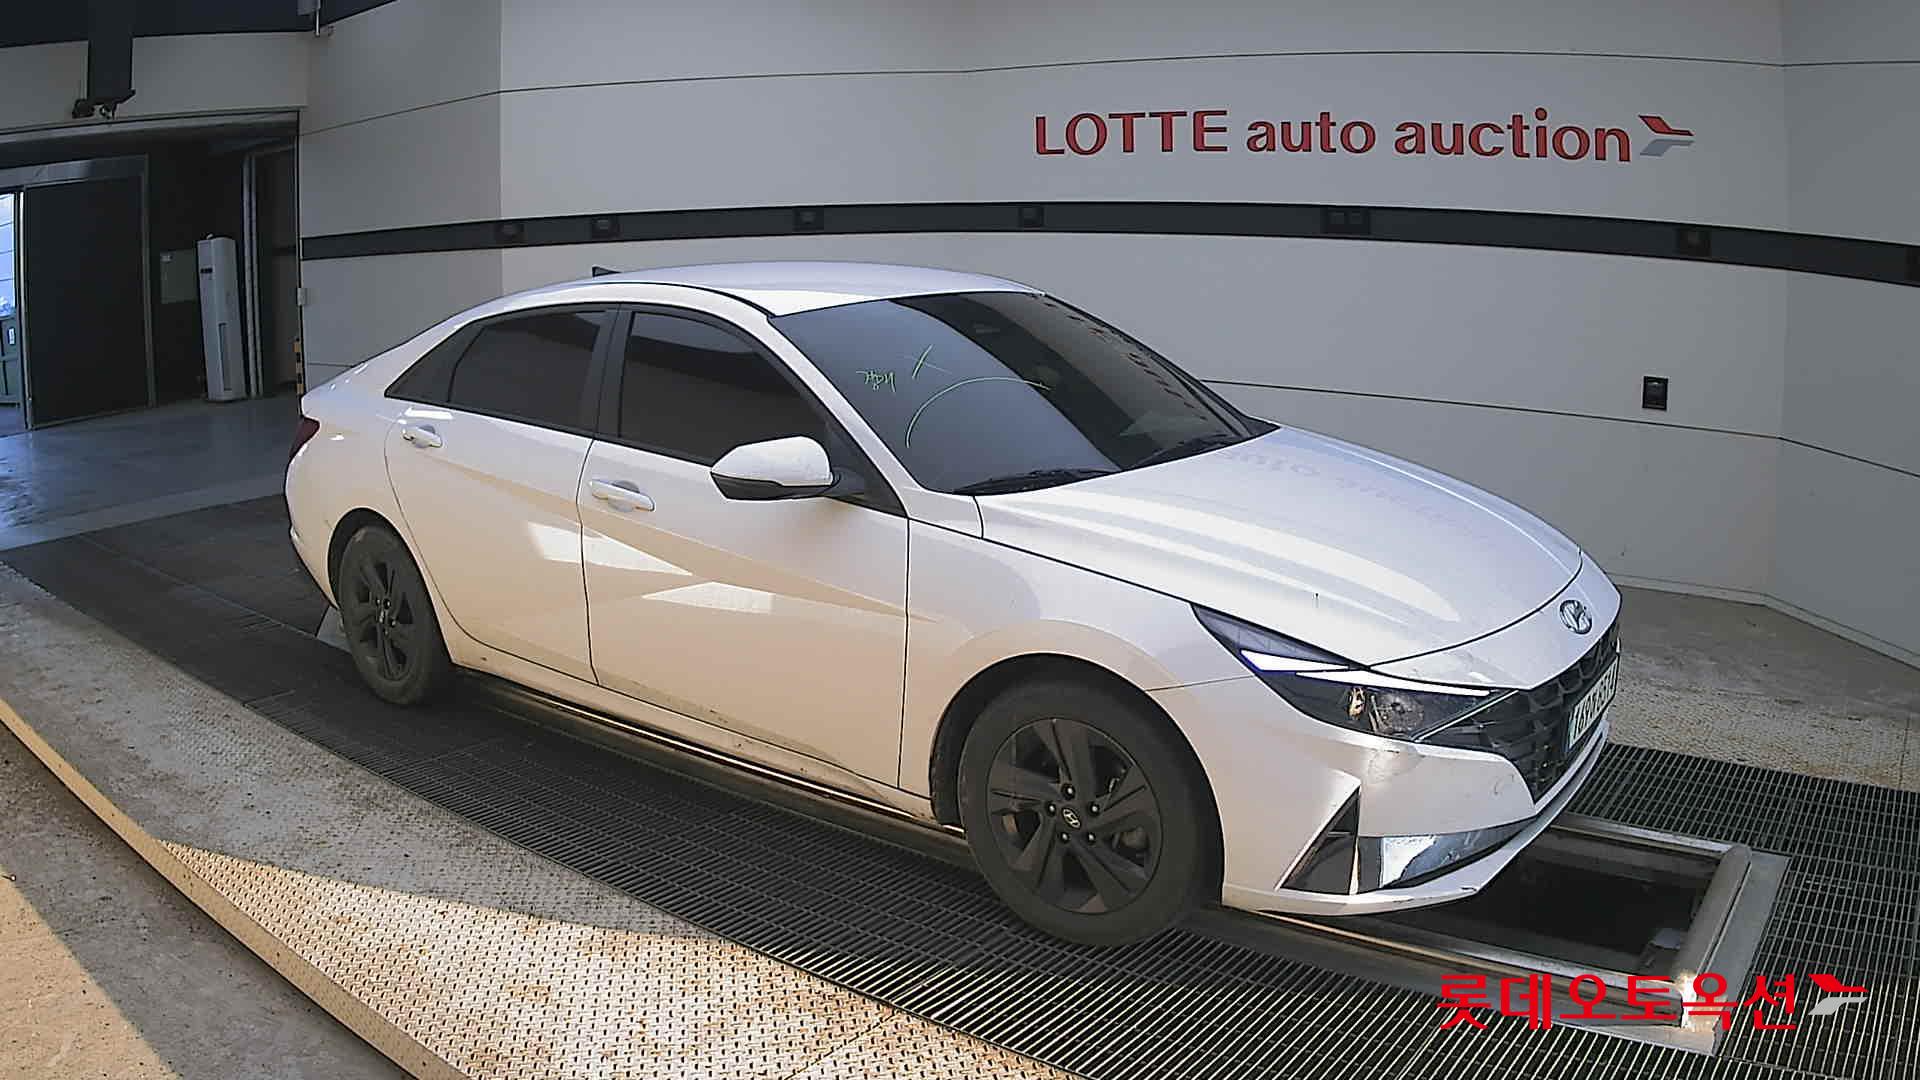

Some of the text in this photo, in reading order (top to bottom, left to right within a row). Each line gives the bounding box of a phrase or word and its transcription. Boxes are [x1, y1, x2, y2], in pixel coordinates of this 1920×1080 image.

[1035, 107, 1631, 162] LOTTE auto auction
